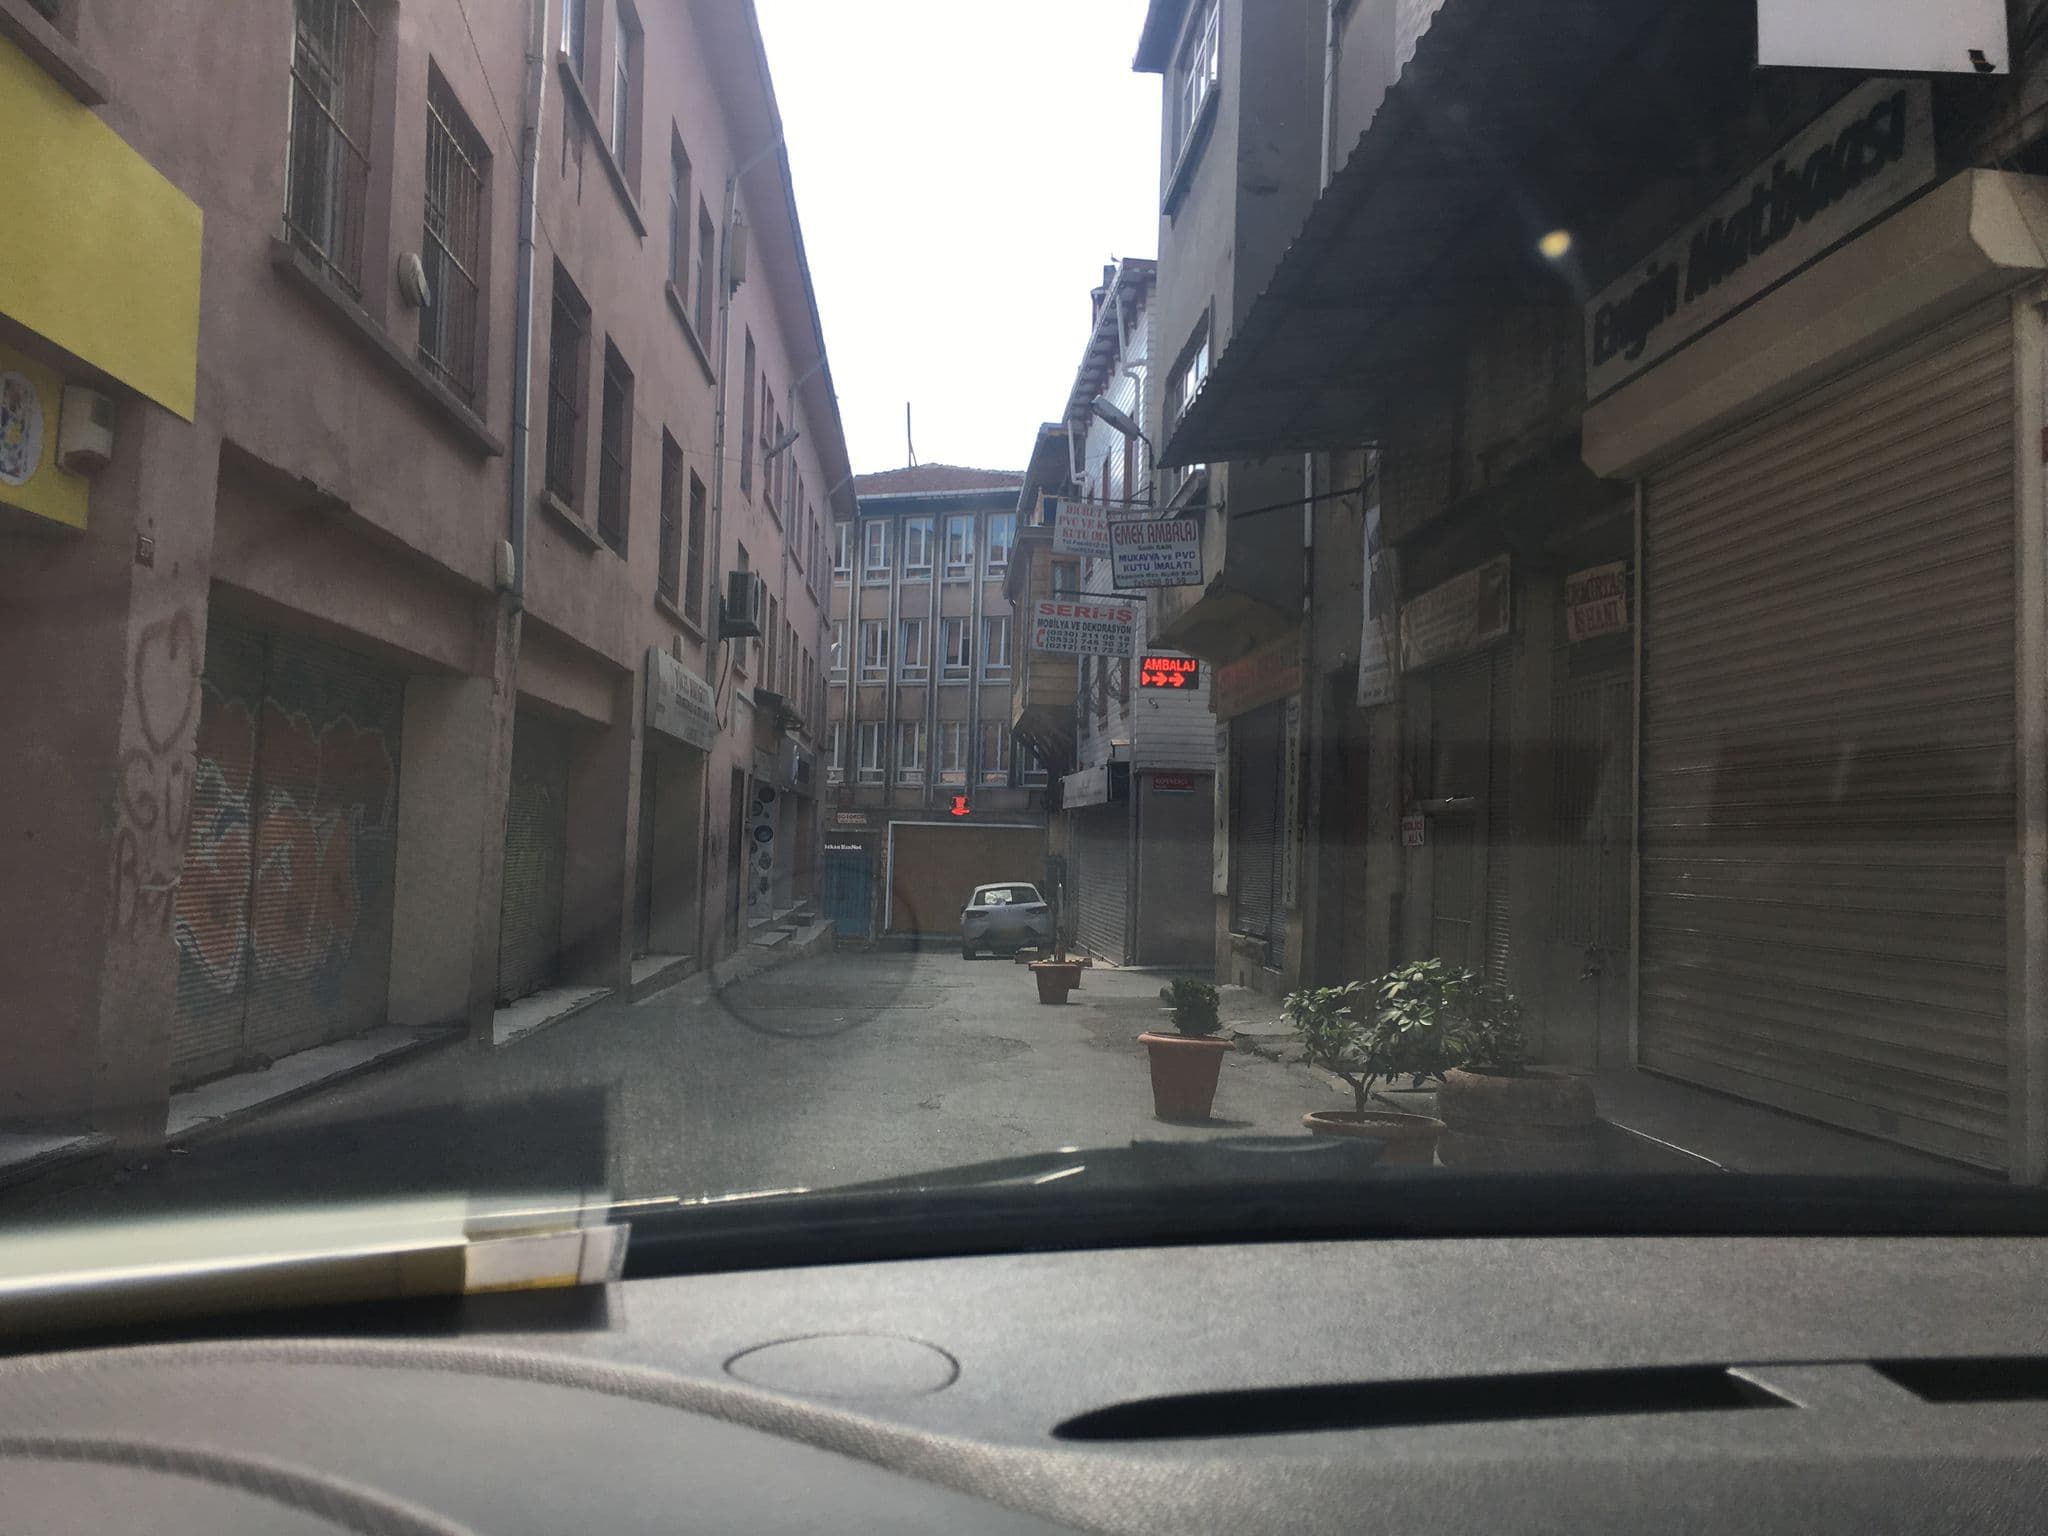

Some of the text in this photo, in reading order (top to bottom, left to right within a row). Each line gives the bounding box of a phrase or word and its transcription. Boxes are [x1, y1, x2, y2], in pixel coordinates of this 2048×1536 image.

[1114, 524, 1144, 545] EMEK
[1147, 521, 1197, 543] AMBALAJ
[1118, 553, 1160, 563] MUKAVVA
[1175, 551, 1196, 560] PVC
[1123, 563, 1150, 572] KUTU
[1071, 621, 1080, 630] VE
[1082, 622, 1132, 634] DEKORASYON
[1143, 657, 1196, 672] AMBALAJ
